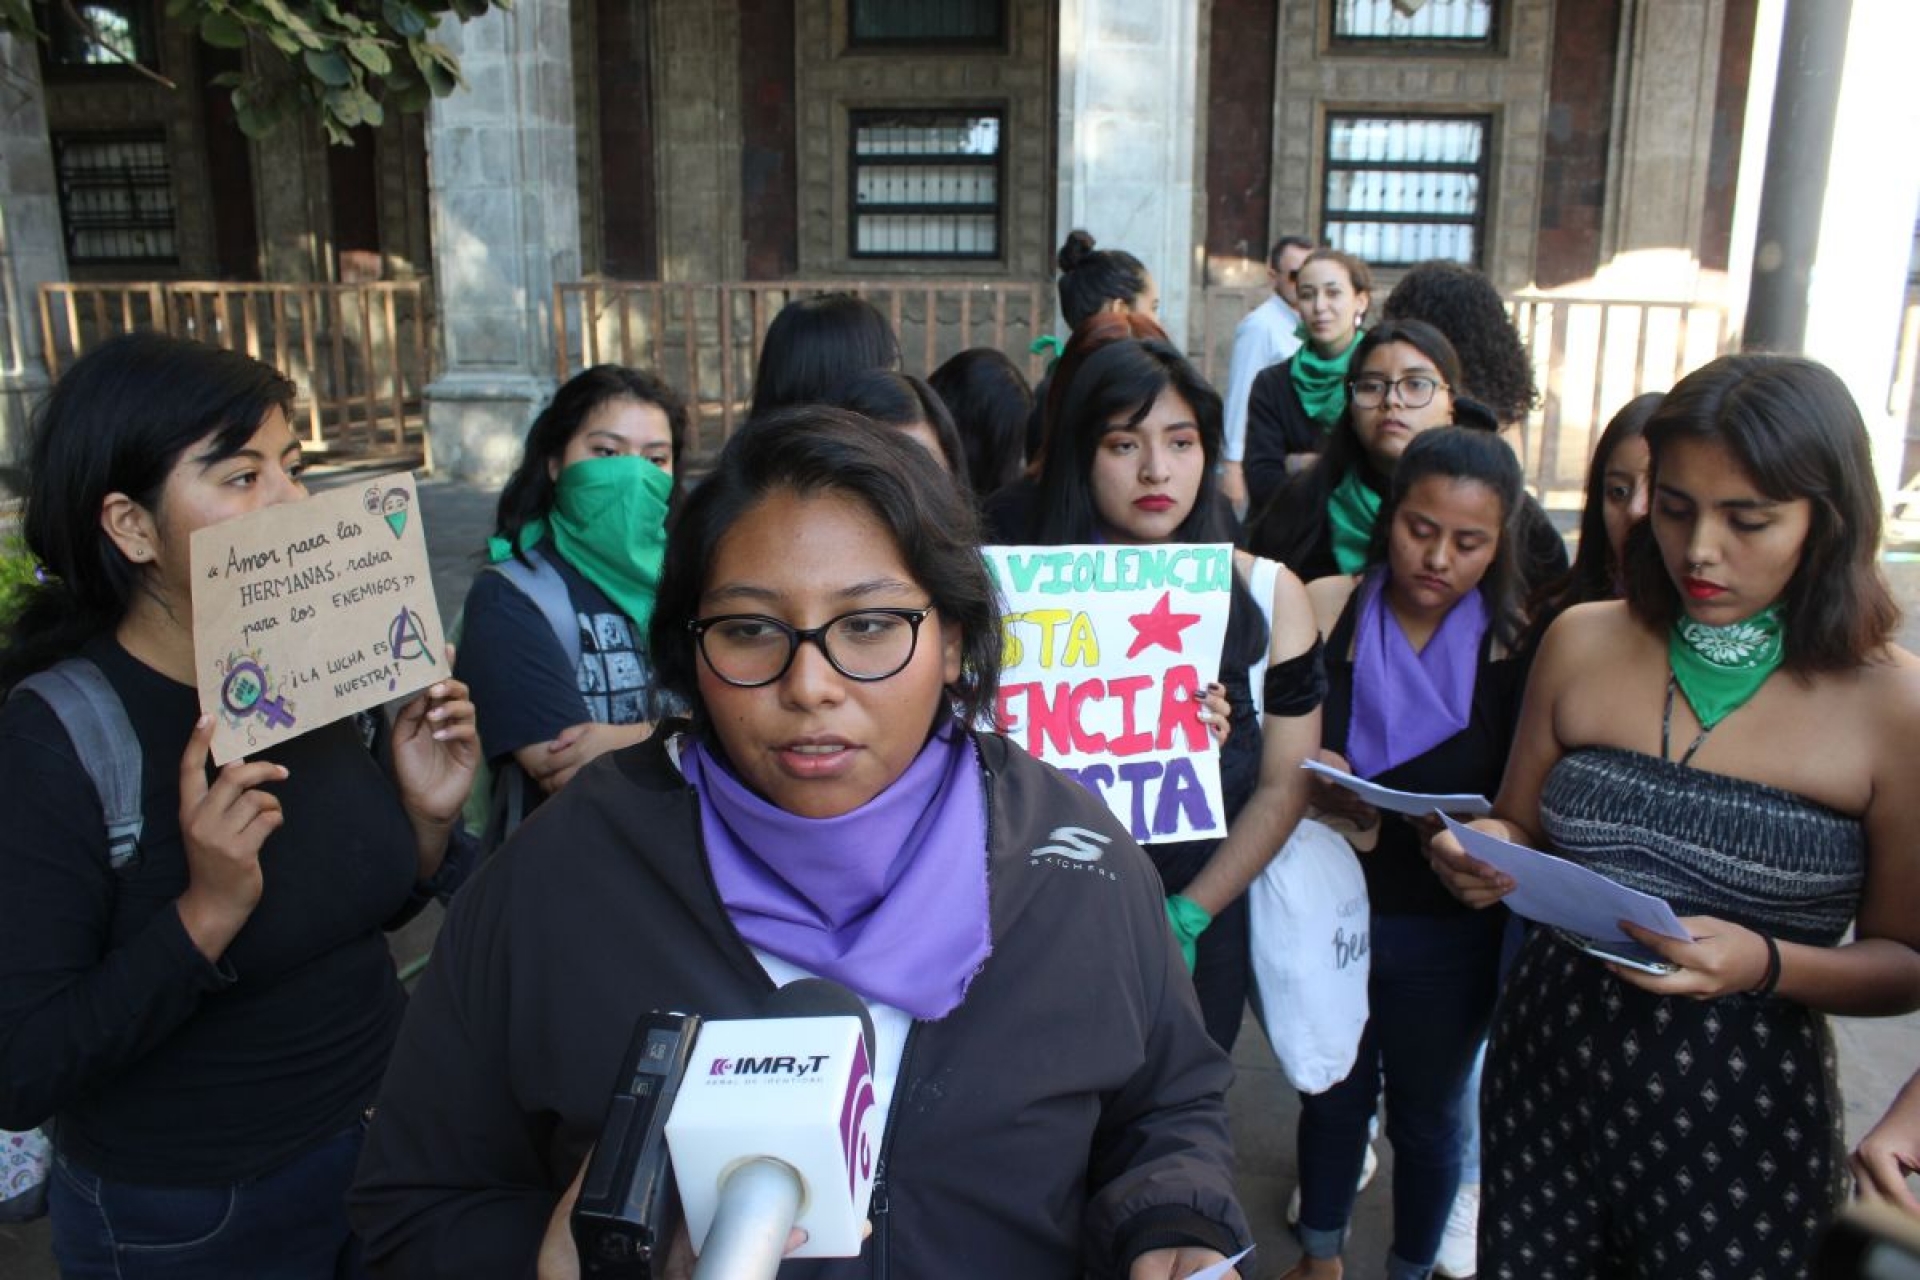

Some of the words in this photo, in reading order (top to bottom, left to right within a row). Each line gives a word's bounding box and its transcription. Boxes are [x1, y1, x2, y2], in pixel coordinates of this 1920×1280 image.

[287, 533, 330, 567] para
[336, 521, 362, 540] las
[346, 549, 393, 572] rabia
[1007, 548, 1231, 595] VIOLENCIA
[241, 616, 280, 646] para
[290, 604, 316, 623] los
[327, 650, 366, 675] LUCHA
[373, 641, 388, 656] ES
